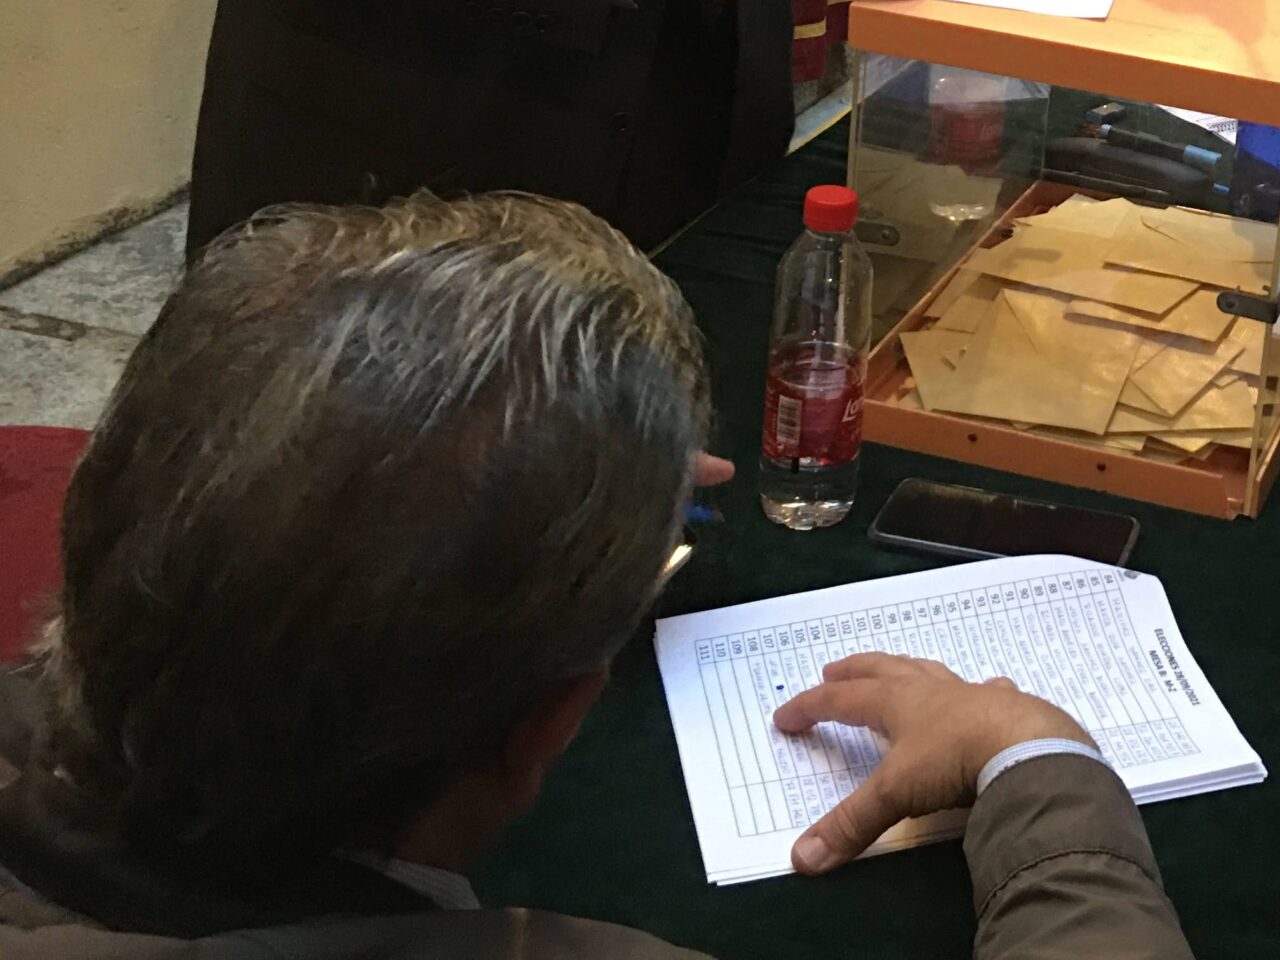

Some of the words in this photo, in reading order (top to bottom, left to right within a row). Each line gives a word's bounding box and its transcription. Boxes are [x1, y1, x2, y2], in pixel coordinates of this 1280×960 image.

[1076, 578, 1086, 589] 86
[1090, 576, 1100, 586] 85
[1104, 574, 1114, 584] 84
[1034, 586, 1043, 597] 89
[1048, 583, 1058, 594] 88
[1063, 580, 1072, 591] 87
[991, 594, 1000, 605] 92
[1005, 592, 1015, 602] 91
[1020, 588, 1030, 600] 90
[947, 602, 957, 613] 95
[962, 600, 971, 610] 94
[977, 596, 986, 608] 93
[902, 610, 912, 621] 98
[917, 607, 926, 618] 97
[932, 604, 941, 616] 96
[856, 616, 867, 632] 101
[871, 614, 883, 630] 100
[887, 613, 897, 624] 99
[810, 625, 821, 641] 104
[825, 622, 836, 638] 103
[840, 620, 852, 635] 102
[763, 634, 774, 649] 107
[778, 631, 790, 646] 106
[794, 628, 805, 643] 105
[715, 642, 726, 658] 110
[731, 640, 742, 654] 109
[747, 636, 758, 652] 108
[1154, 628, 1180, 670] ELECCIONES
[699, 645, 710, 660] 111
[1149, 650, 1164, 670] MESA
